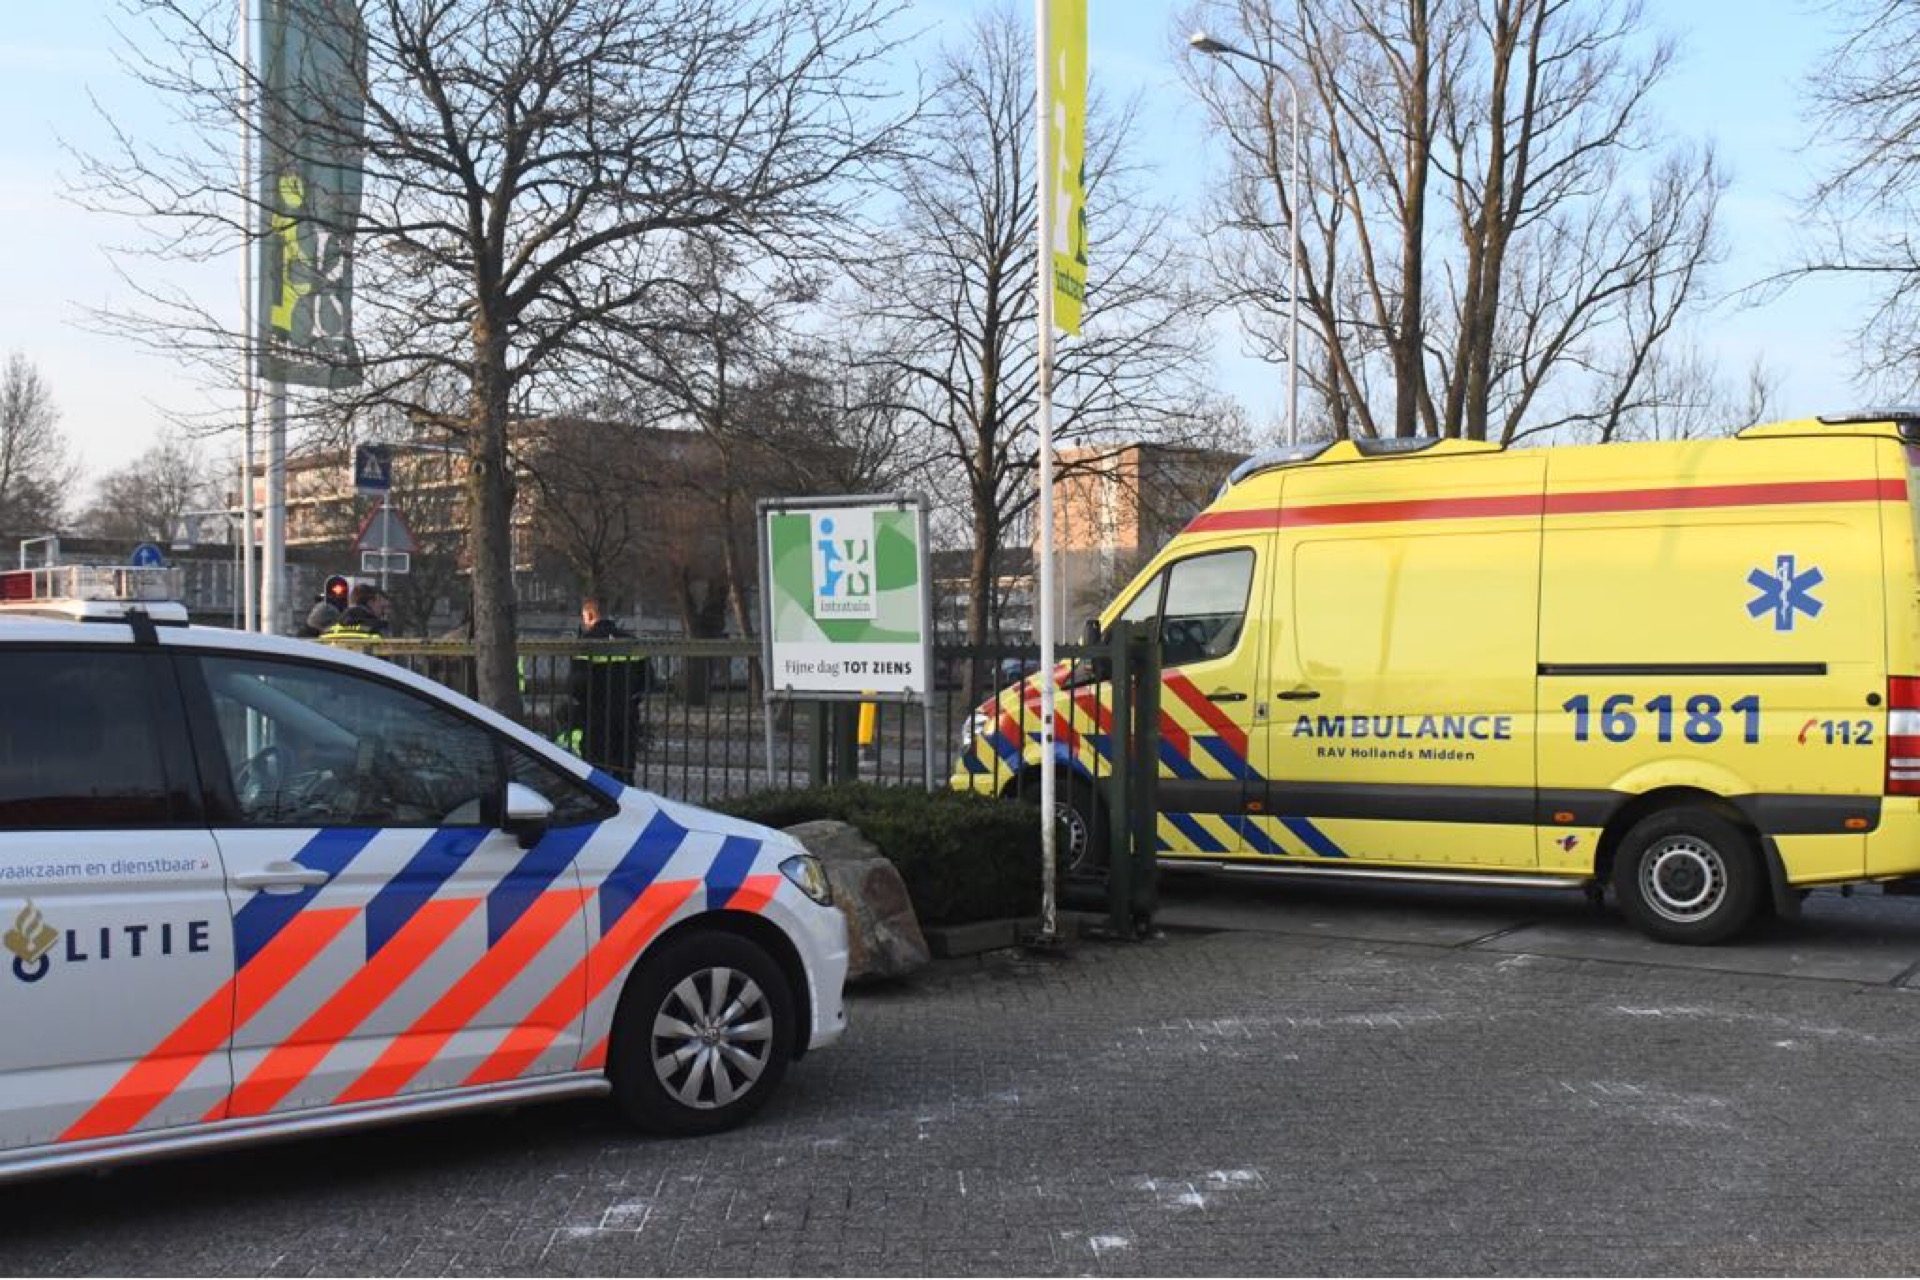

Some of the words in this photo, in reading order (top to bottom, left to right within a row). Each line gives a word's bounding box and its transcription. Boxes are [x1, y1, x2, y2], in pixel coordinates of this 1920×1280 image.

[785, 660, 814, 675] Fijne
[817, 659, 839, 677] dag
[843, 661, 868, 674] TOT
[872, 660, 912, 675] ZIENS
[1292, 715, 1512, 740] AMBULANCE
[1562, 694, 1760, 744] 16181
[1317, 747, 1346, 758] RAV
[1351, 748, 1414, 760] Hollands
[1418, 749, 1475, 761] Midden
[86, 863, 106, 876] en
[111, 858, 196, 874] dienstbaar
